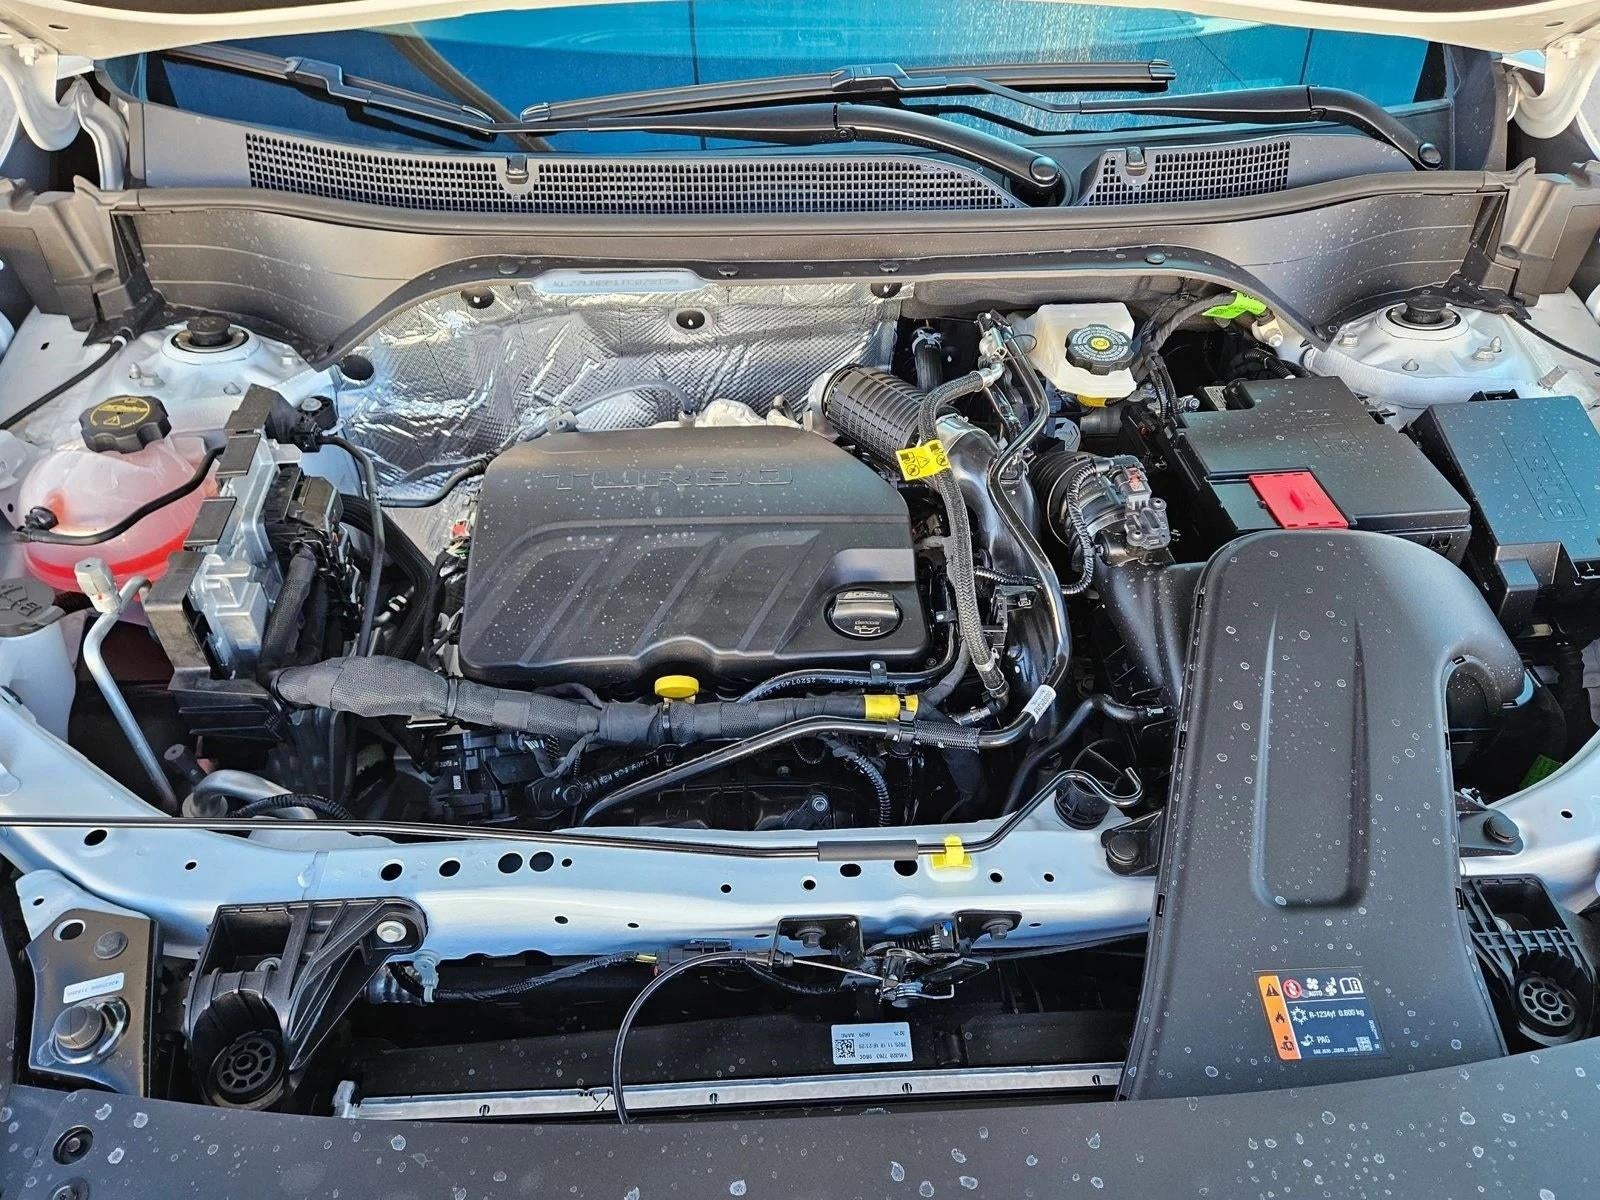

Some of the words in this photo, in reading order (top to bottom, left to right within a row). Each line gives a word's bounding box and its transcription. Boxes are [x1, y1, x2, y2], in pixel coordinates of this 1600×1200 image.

[542, 467, 794, 490] TURBO
[844, 591, 889, 600] ACDelco
[1308, 1009, 1336, 1019] R-1234yf
[1316, 1035, 1331, 1045] PAG
